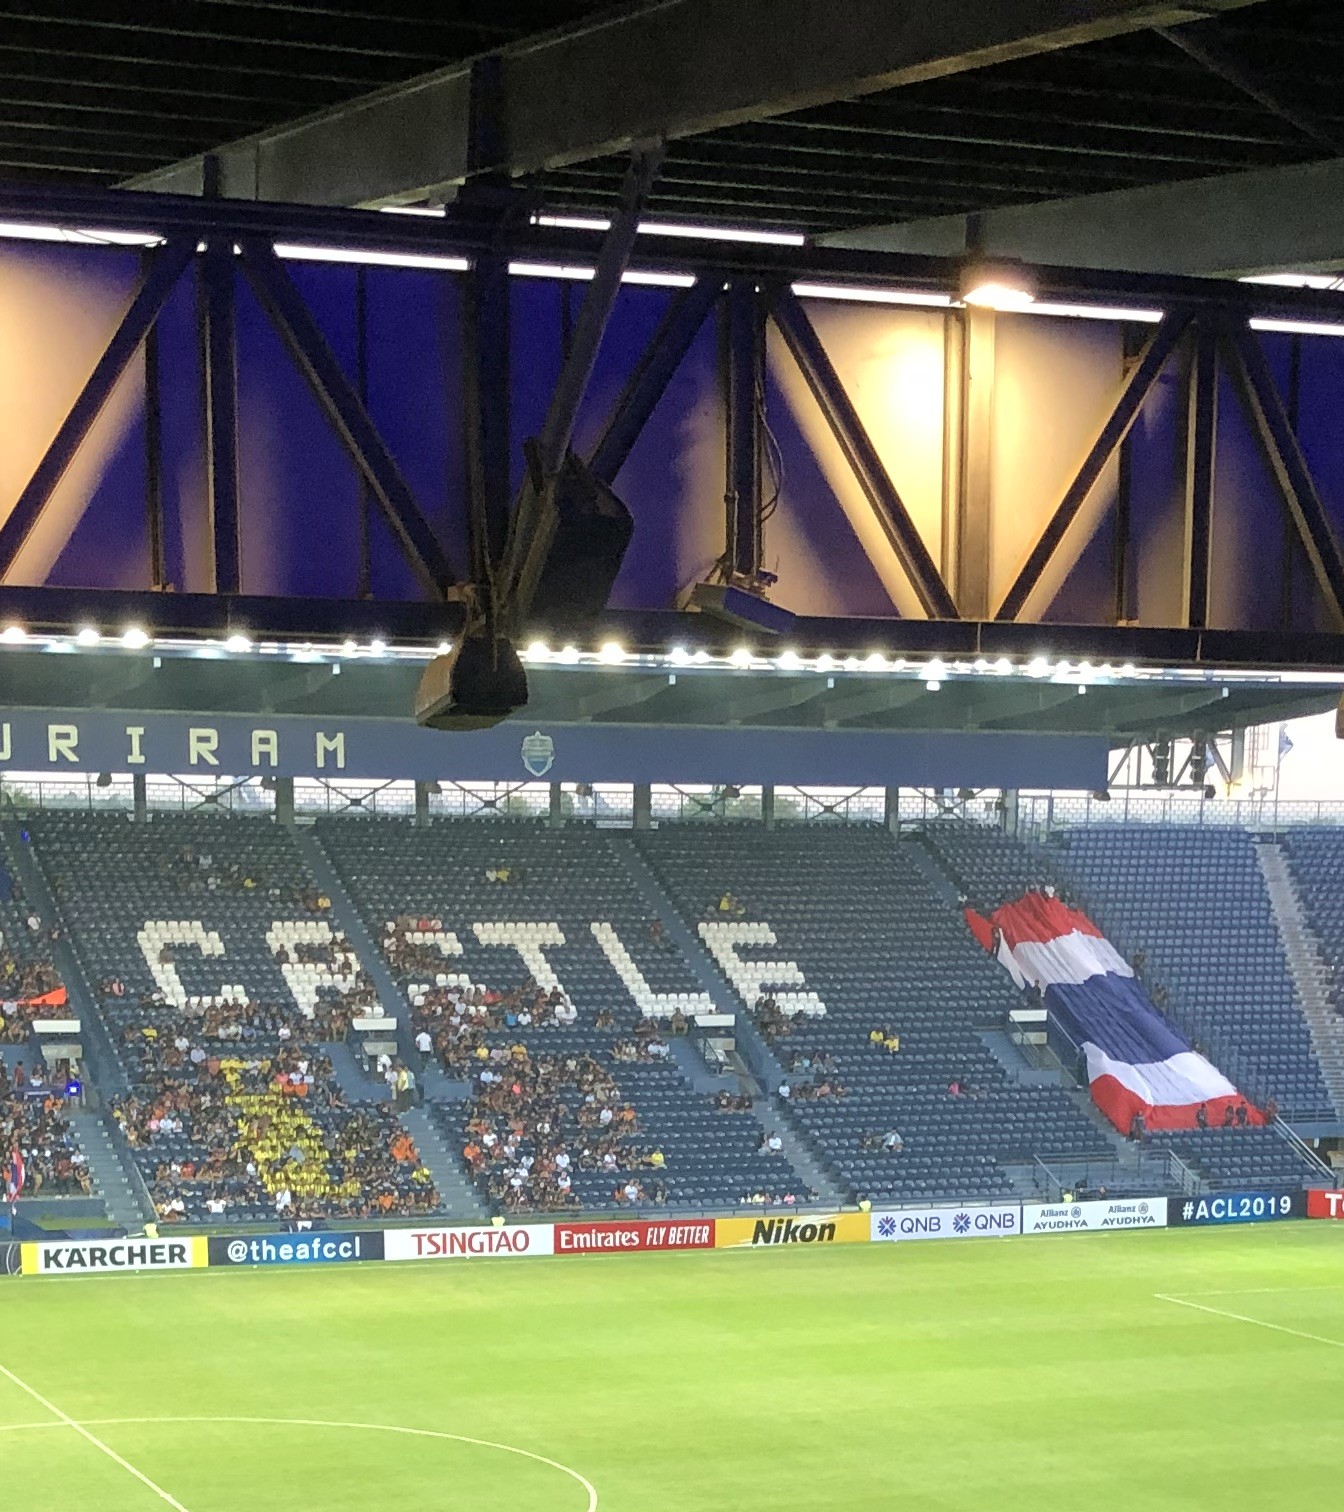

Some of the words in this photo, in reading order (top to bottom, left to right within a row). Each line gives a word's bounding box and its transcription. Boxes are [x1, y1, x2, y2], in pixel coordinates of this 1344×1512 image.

[1040, 1208, 1069, 1218] Allianz
[1108, 1205, 1136, 1215] Allianz
[1182, 1196, 1291, 1220] #ACL2019
[900, 1217, 942, 1233] QNB
[974, 1213, 1015, 1230] QNB
[1033, 1218, 1088, 1230] AYUDHYA
[1101, 1215, 1156, 1226] AYUDHYA
[560, 1228, 639, 1249] Emirates
[646, 1225, 666, 1246] FLY
[668, 1224, 710, 1245] BETTER
[752, 1220, 836, 1245] Nikon
[227, 1237, 360, 1262] @theafccl
[411, 1230, 530, 1256] TSINGTAO
[43, 1243, 187, 1268] KÄRCHER
